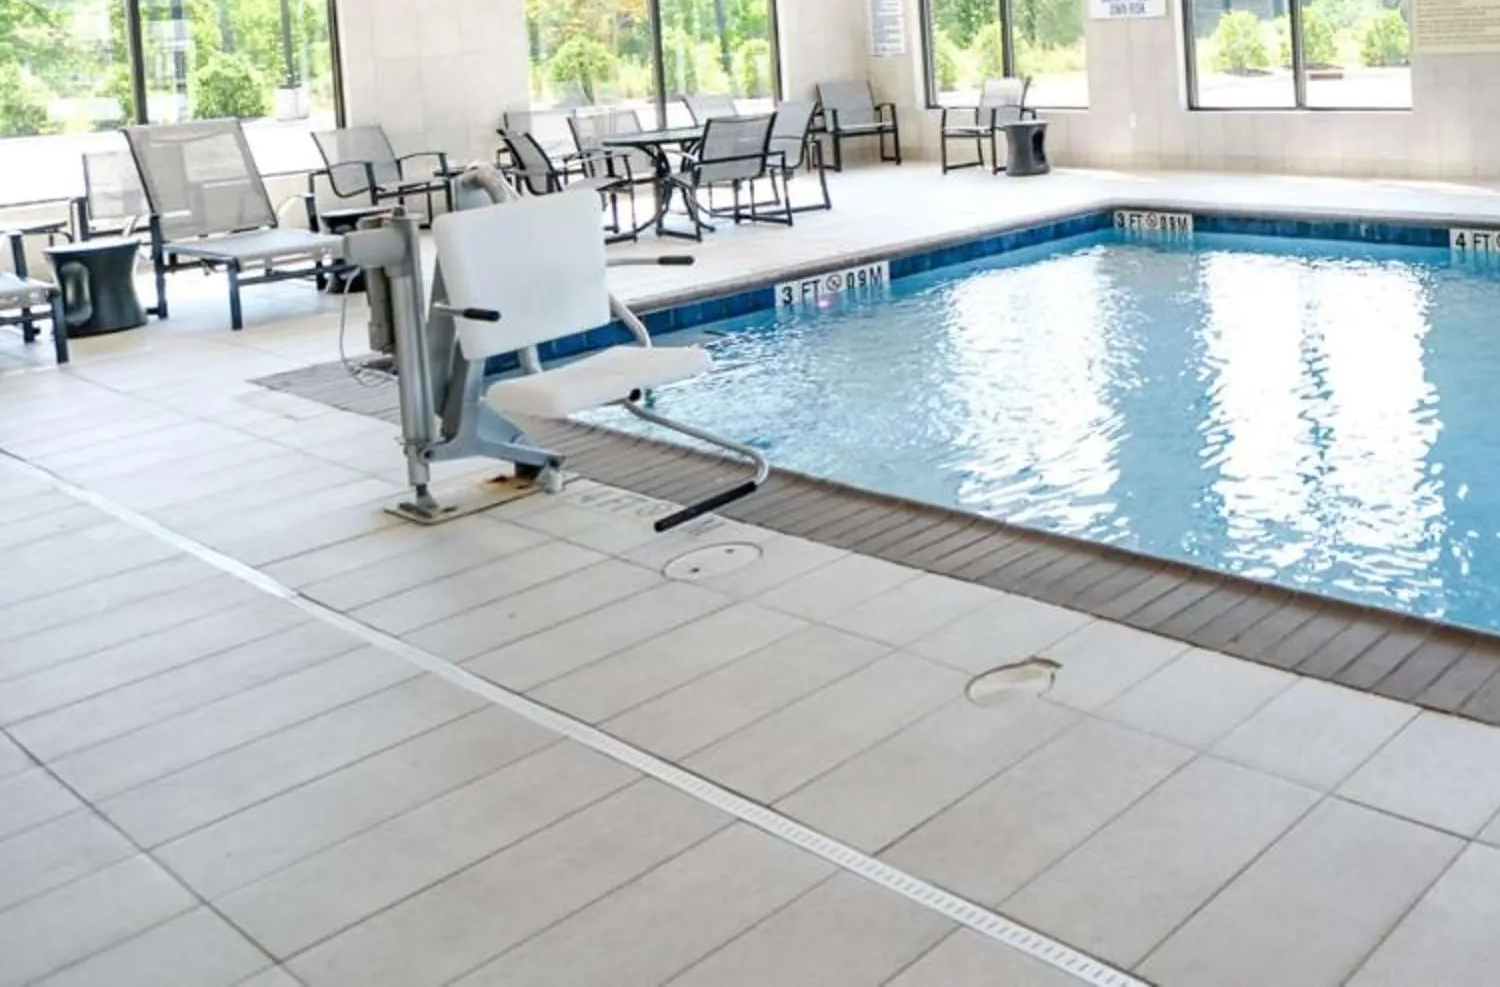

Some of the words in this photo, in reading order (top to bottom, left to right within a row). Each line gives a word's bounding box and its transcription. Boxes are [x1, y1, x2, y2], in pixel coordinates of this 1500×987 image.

[1456, 232, 1466, 252] 4
[1473, 233, 1490, 251] FT
[782, 286, 793, 305] 3
[801, 279, 821, 302] FT
